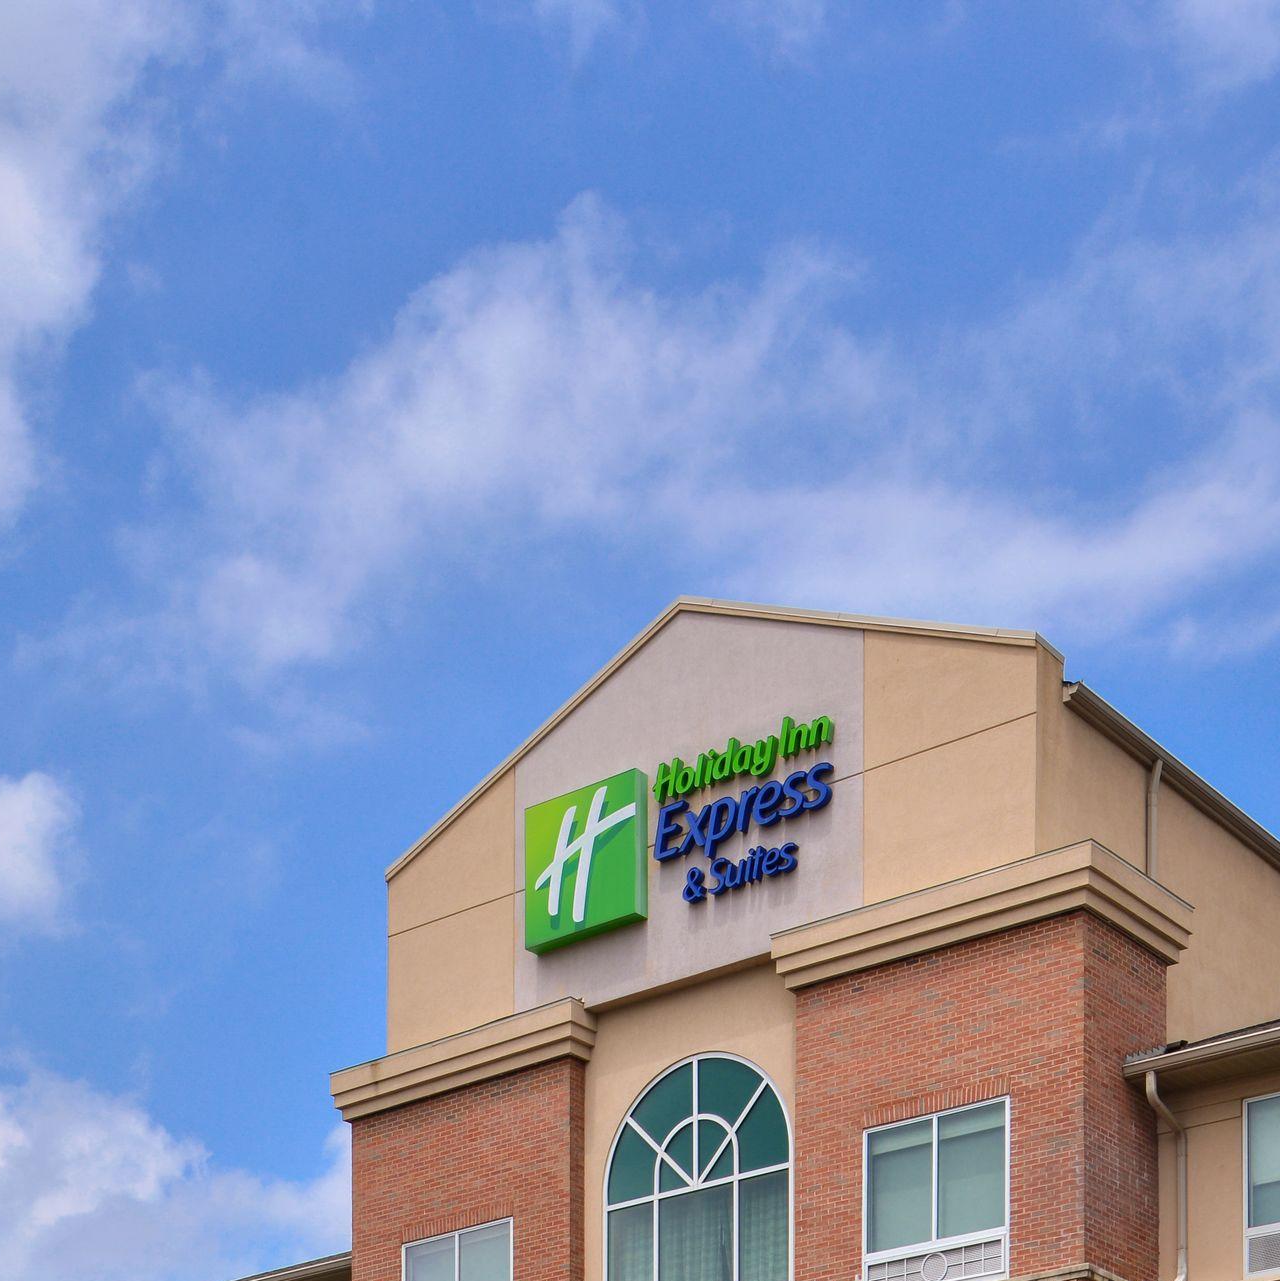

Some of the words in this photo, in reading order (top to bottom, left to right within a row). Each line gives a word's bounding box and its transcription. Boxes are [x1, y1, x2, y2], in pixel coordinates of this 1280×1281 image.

[653, 735, 779, 805] Holiday
[779, 716, 835, 760] Inn
[654, 762, 835, 862] Express
[683, 867, 708, 904] &
[708, 842, 799, 896] Suites
